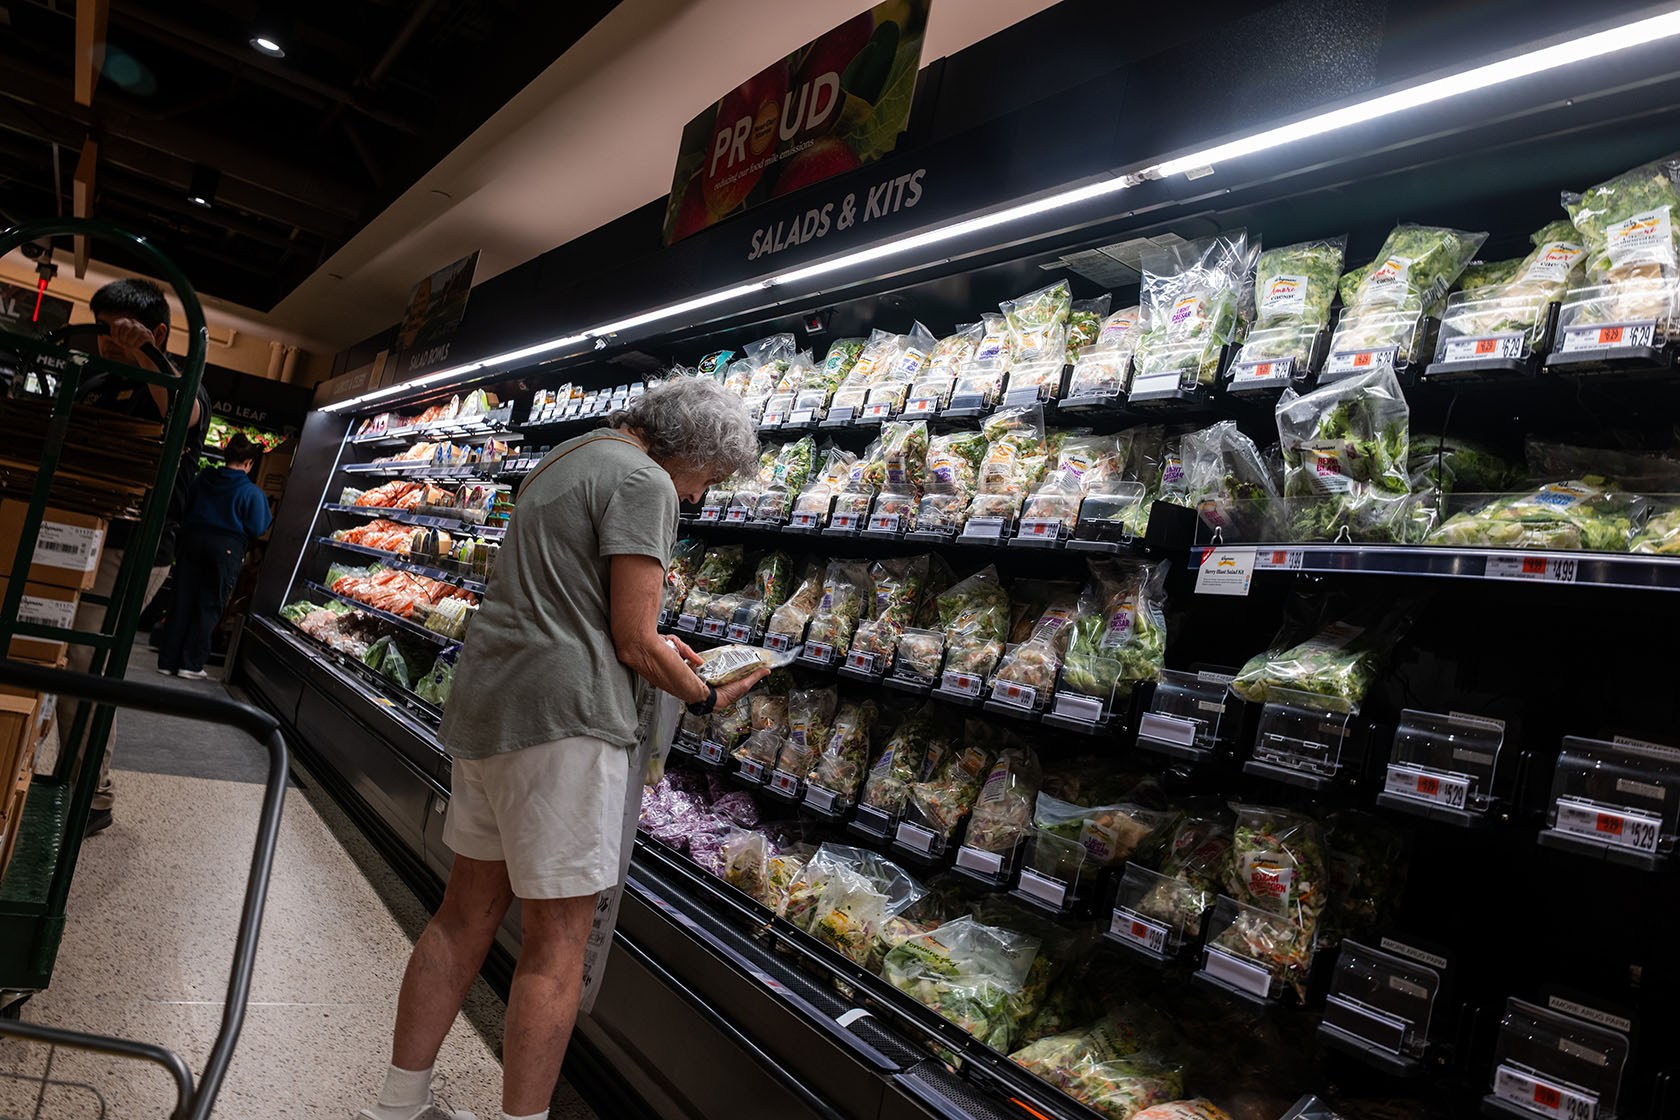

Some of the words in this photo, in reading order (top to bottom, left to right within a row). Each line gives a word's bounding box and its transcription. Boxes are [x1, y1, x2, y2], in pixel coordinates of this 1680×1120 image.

[713, 173, 738, 191] reducing
[737, 166, 750, 179] our
[750, 157, 766, 174] food
[765, 152, 779, 167] mile
[779, 138, 816, 159] emissions
[747, 202, 834, 260] SALADS
[837, 193, 856, 231] &
[863, 168, 926, 222] KITS
[1502, 338, 1521, 357] $629
[1630, 326, 1651, 347] $629
[235, 405, 268, 422] LEAF
[1163, 472, 1184, 481] CAESAR
[1553, 560, 1575, 582] $499
[1445, 784, 1464, 806] $529
[1632, 822, 1655, 849] $529
[1551, 999, 1579, 1013] AMORE
[1605, 1014, 1629, 1029] PARM
